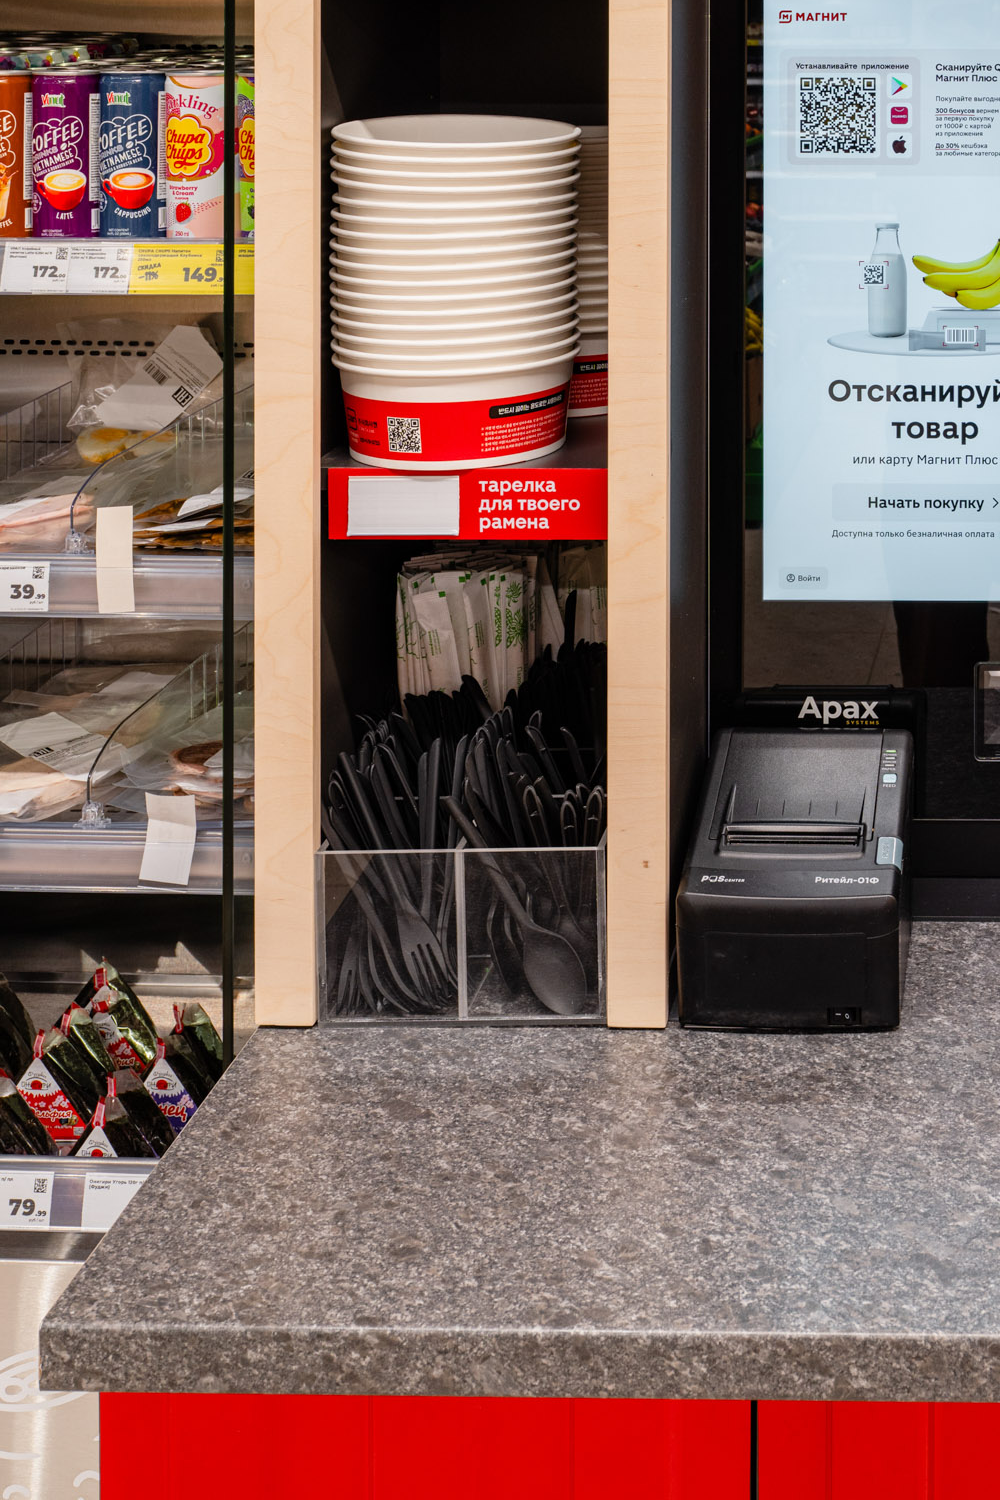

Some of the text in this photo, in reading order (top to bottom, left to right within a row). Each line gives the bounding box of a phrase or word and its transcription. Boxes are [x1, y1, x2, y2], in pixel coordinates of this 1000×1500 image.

[795, 12, 847, 22] МАГНИТ
[935, 63, 992, 73] Сканируйте
[935, 74, 998, 82] Магнит Плюс
[935, 95, 972, 103] Покупайте
[166, 128, 206, 147] Chupa
[166, 144, 204, 161] Chups
[56, 211, 74, 220] LATTE
[114, 206, 151, 219] CAPPUCCINO
[182, 267, 224, 282] 149.9
[891, 421, 979, 445] товар
[852, 454, 998, 467] или карту Магнит Плюс
[478, 480, 556, 496] тарелка
[478, 498, 581, 513] для твоего
[868, 497, 984, 512] Начать покупку
[479, 516, 550, 532] рамена
[831, 529, 995, 539] Доступна только безналичная оплата
[798, 574, 821, 582] Войти
[10, 584, 46, 599] 39.99
[798, 696, 879, 725] Apax
[815, 876, 880, 884] Ритейл-01Ф
[158, 1104, 188, 1121] нец
[8, 1198, 47, 1217] 79.99
